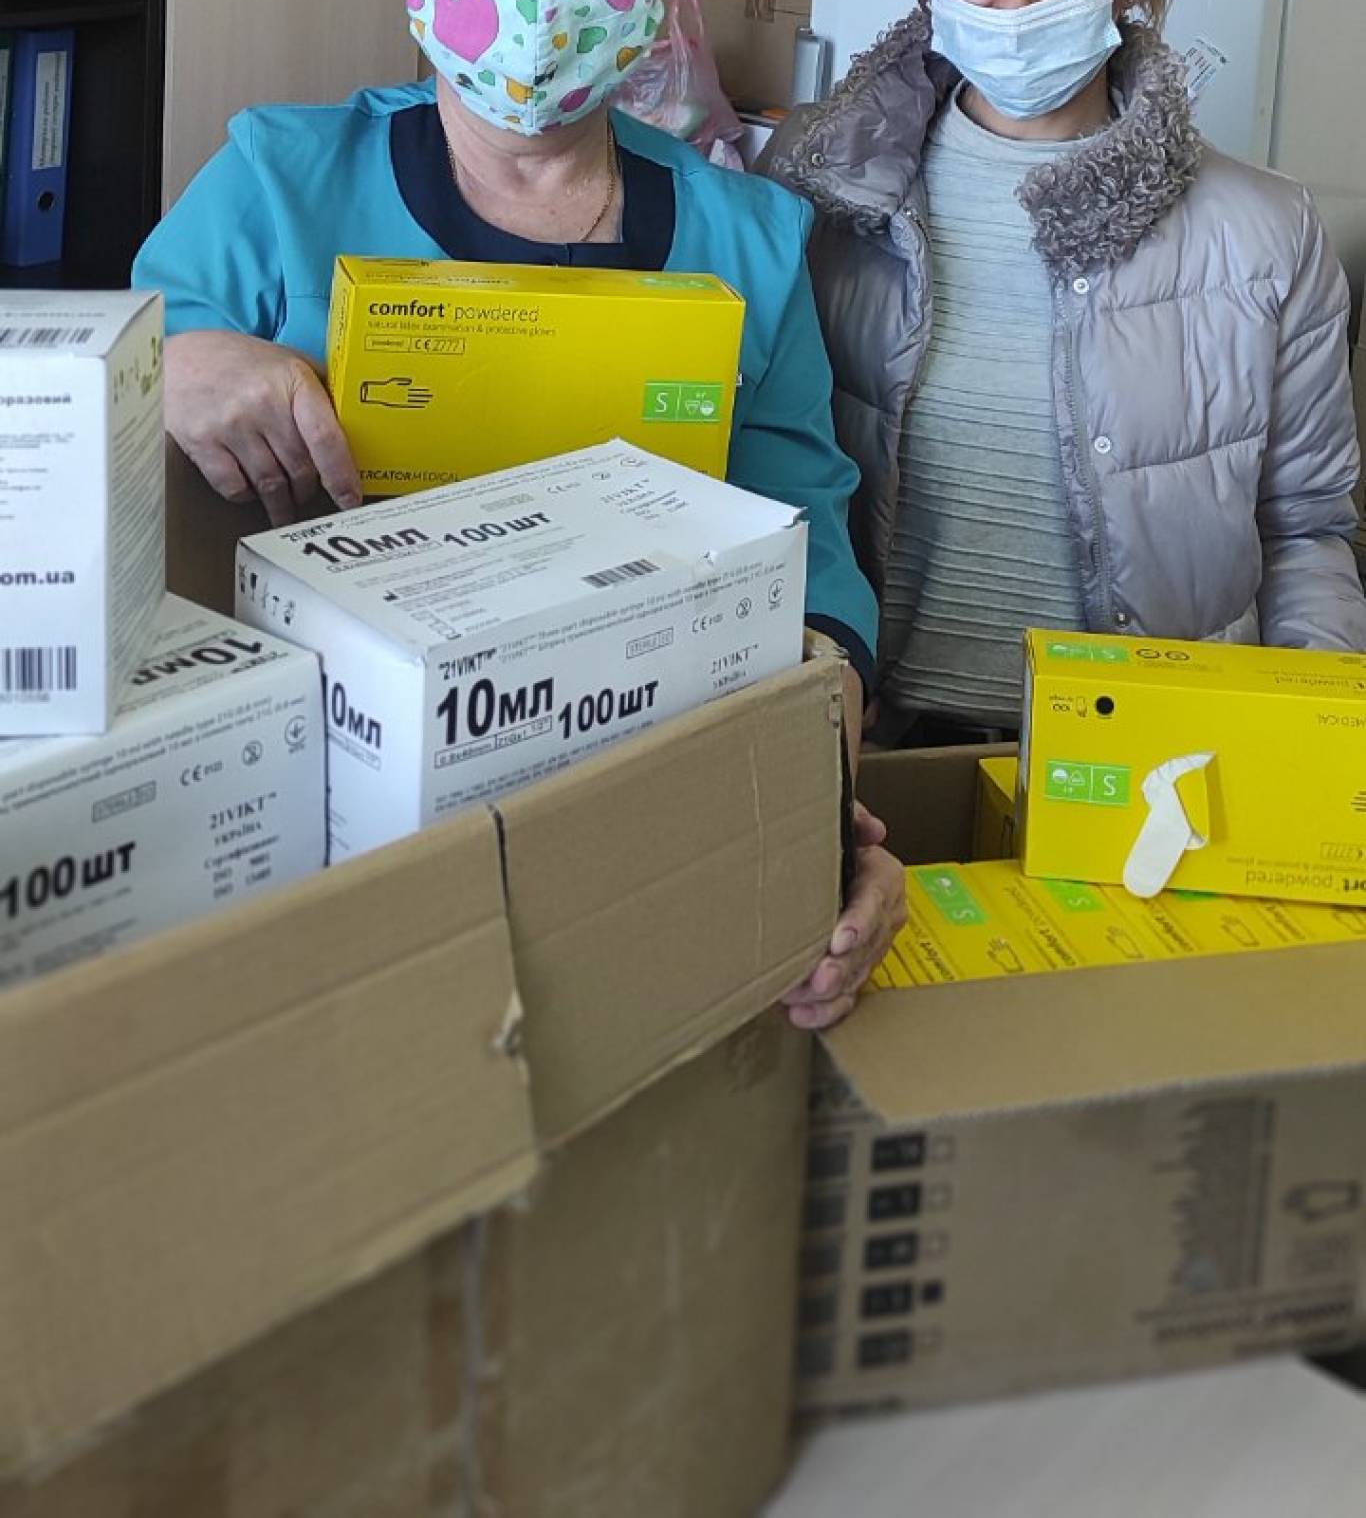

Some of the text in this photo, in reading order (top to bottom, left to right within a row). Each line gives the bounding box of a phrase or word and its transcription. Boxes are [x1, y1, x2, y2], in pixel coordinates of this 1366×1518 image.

[368, 298, 541, 324] comfort powdered
[655, 392, 669, 413] S
[303, 511, 551, 564] 10мл 100шт
[131, 638, 263, 686] 10мл
[436, 676, 660, 746] 10мл 100шт
[1103, 775, 1117, 796] S
[0, 840, 137, 919] 100шт
[1245, 869, 1333, 890] powdered
